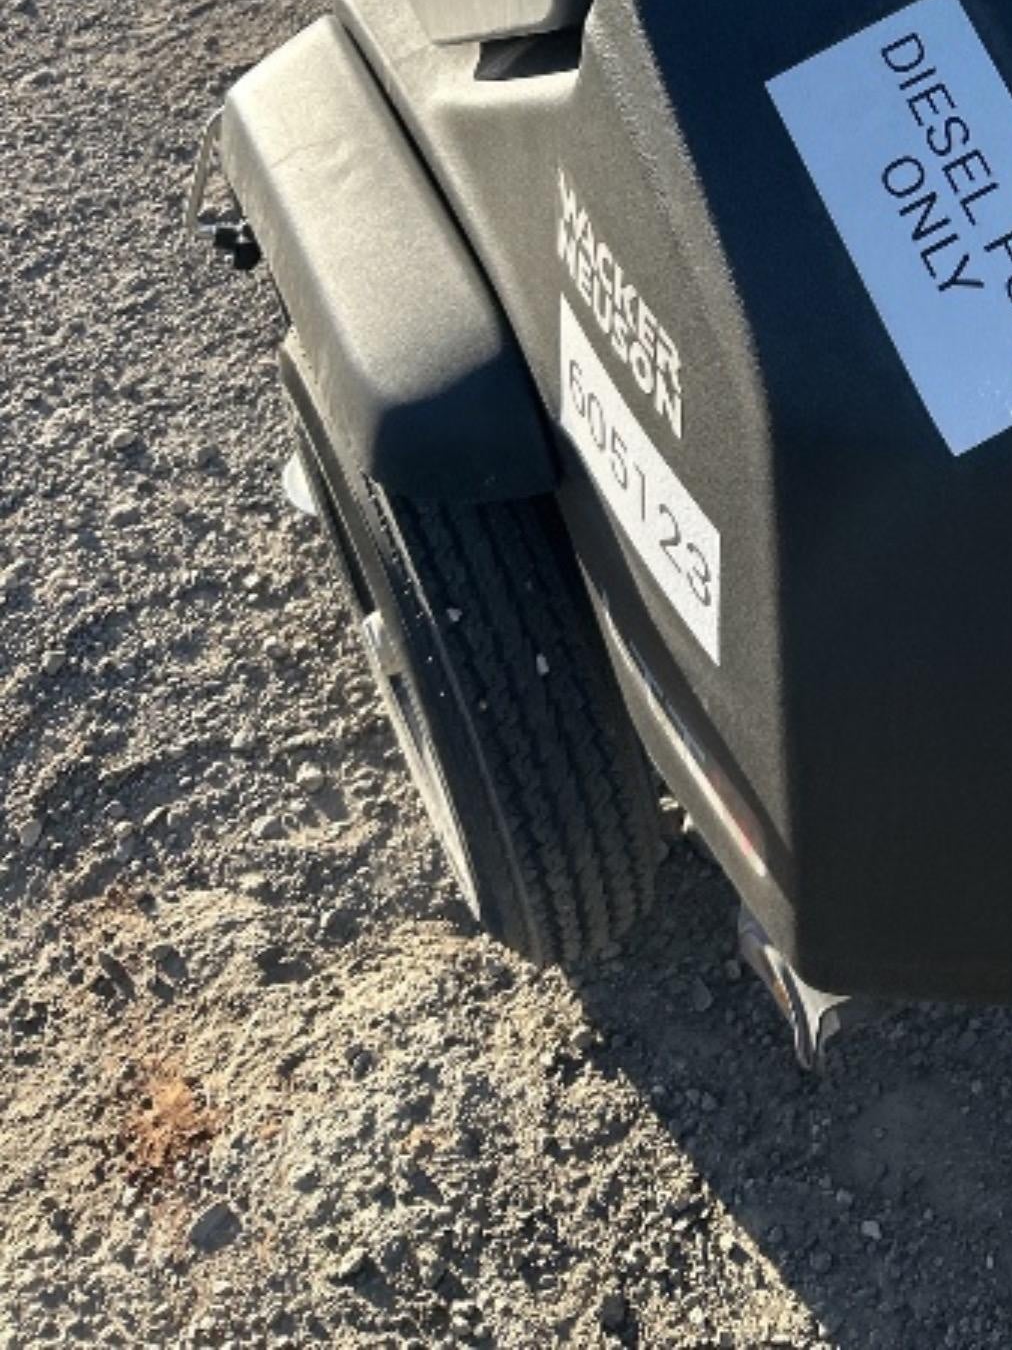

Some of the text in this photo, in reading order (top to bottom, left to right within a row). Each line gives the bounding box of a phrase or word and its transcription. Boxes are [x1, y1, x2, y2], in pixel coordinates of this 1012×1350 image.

[881, 32, 1000, 226] DIESEL
[881, 155, 985, 293] ONLY
[558, 168, 682, 395] WACKER
[558, 217, 682, 440] NEUSON
[569, 359, 712, 608] 605123
